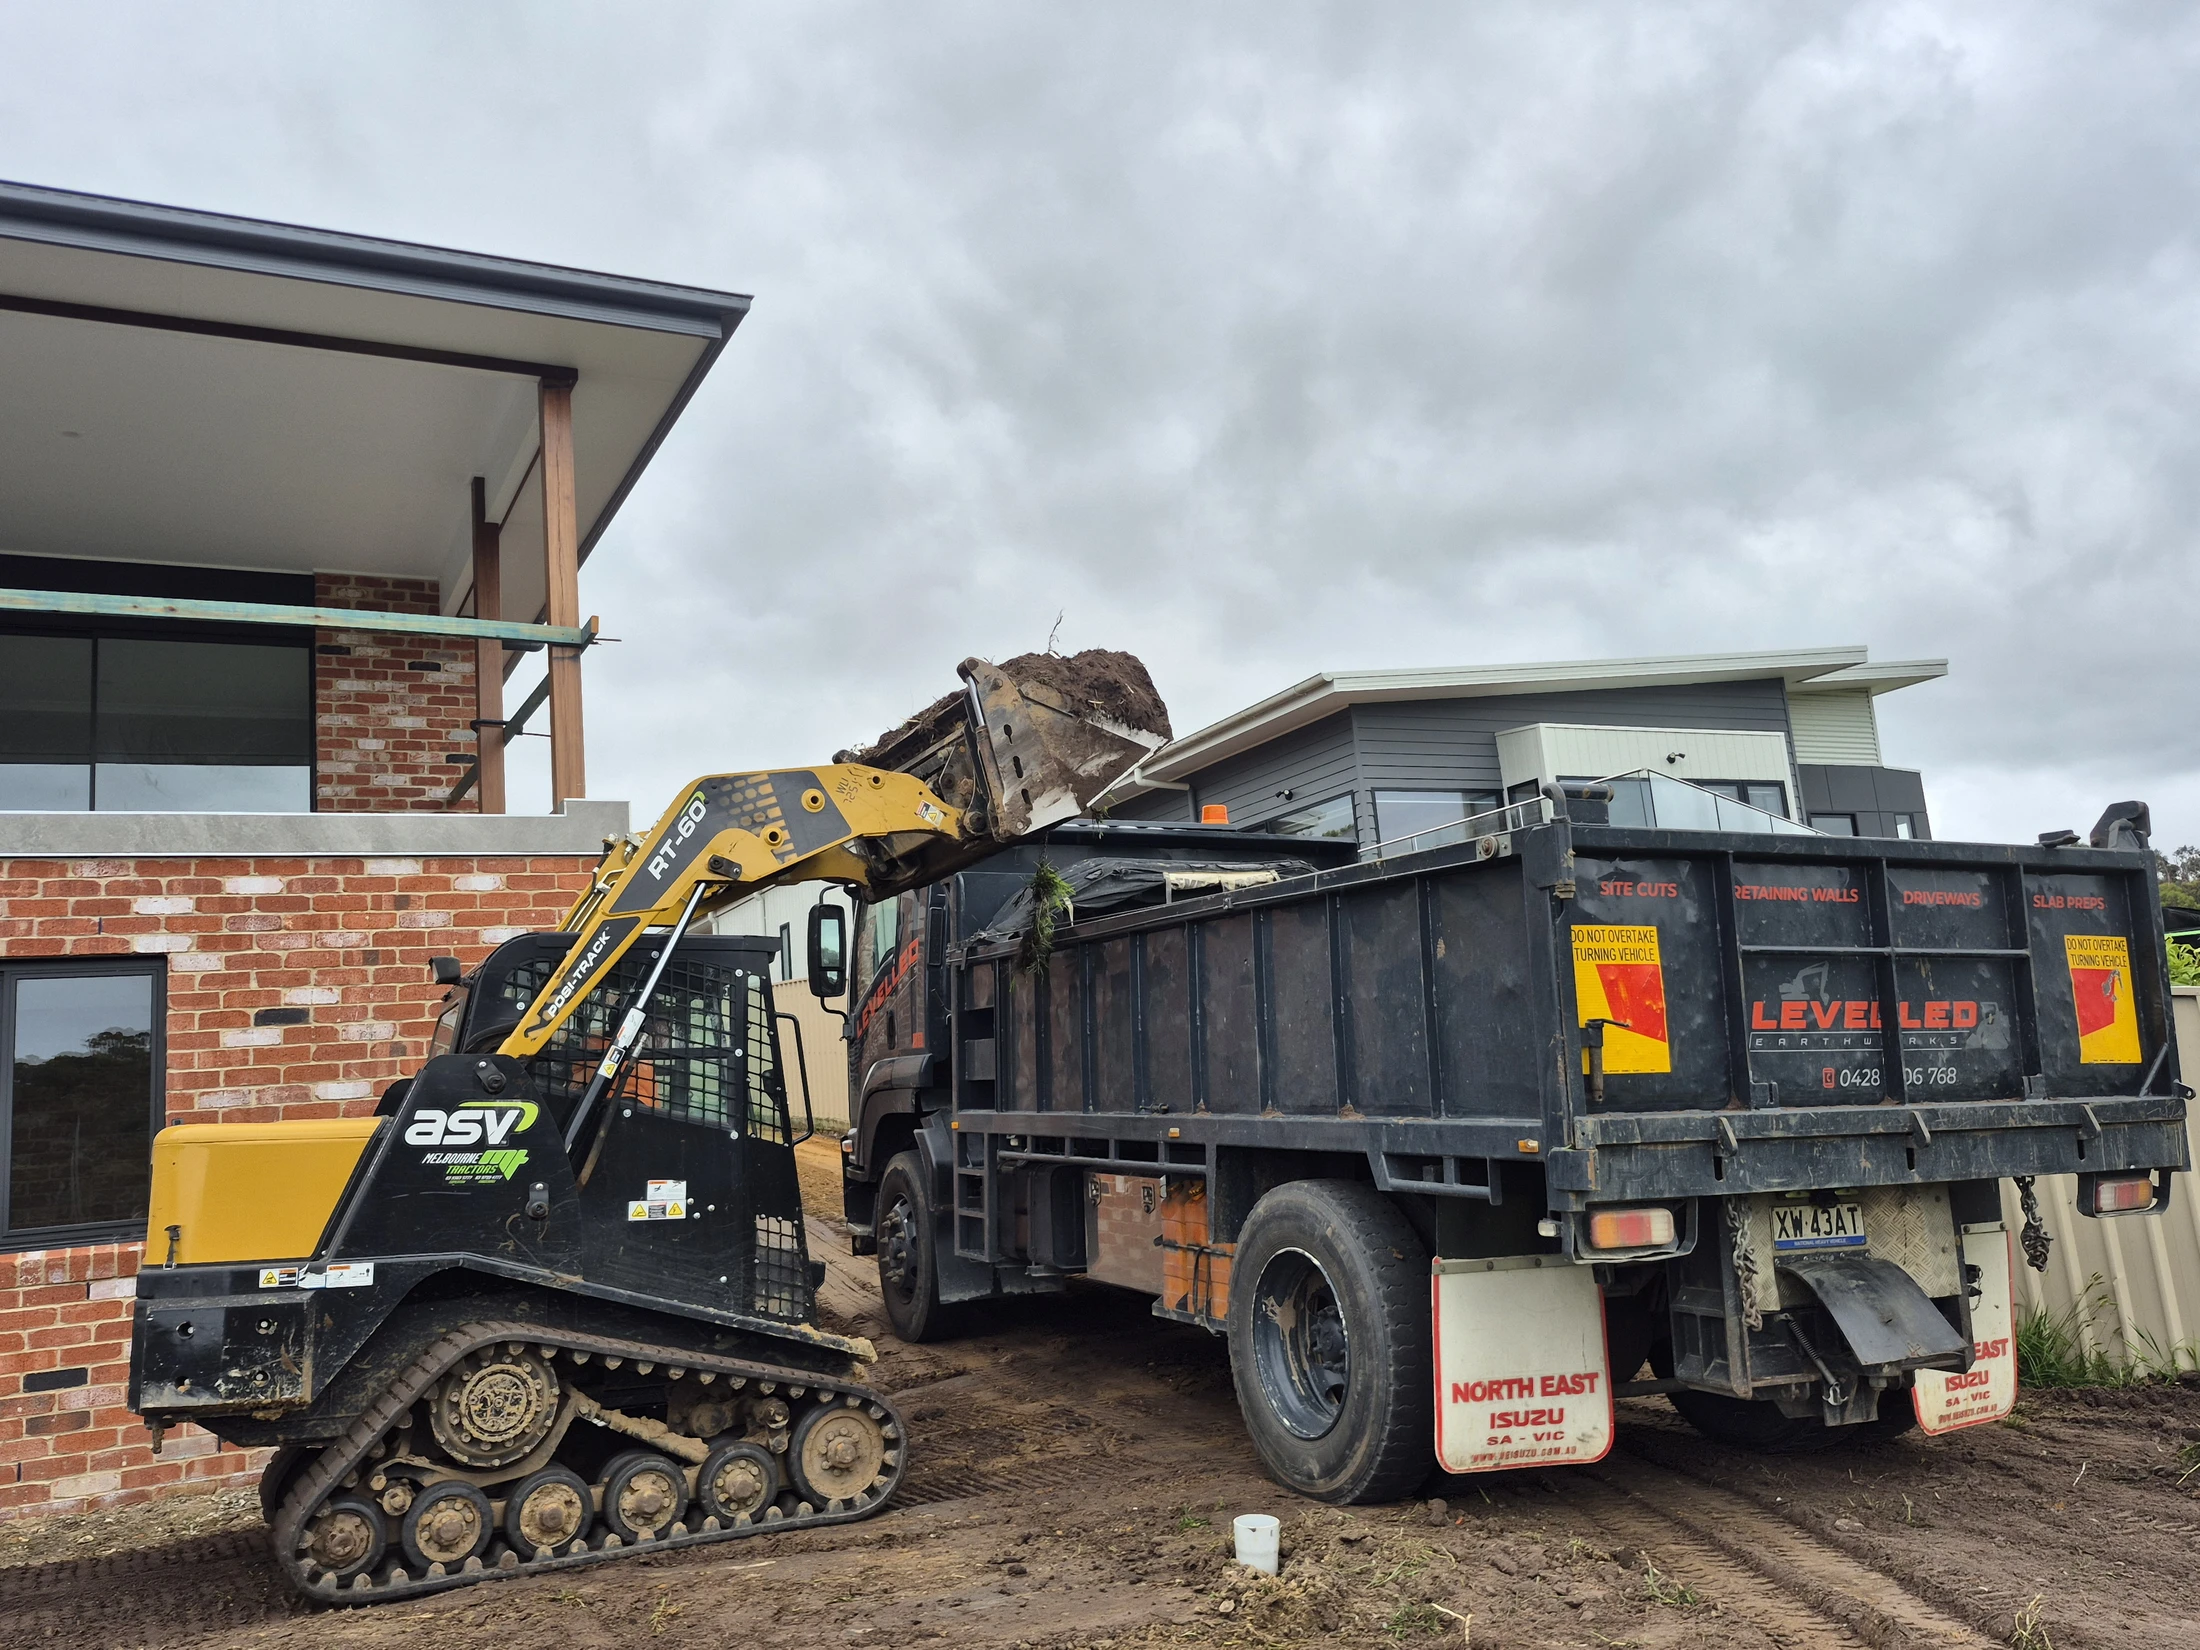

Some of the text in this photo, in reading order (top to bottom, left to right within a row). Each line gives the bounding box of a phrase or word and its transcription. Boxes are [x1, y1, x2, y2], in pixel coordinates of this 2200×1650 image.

[647, 800, 707, 881] RT-60
[1600, 881, 1677, 897] SITE CUTS
[1734, 885, 1859, 902] RETAINING WALLS
[1903, 891, 1980, 906] DRIVEWAYS
[2033, 894, 2105, 910] SLAB PREPS
[1571, 929, 1655, 944] DO NOT OVERTAKE
[2066, 937, 2127, 952] DO NOT OVERTAKE
[1574, 947, 1655, 962] TURNING VEHICLE
[2070, 954, 2128, 968] TURNING VEHICLE
[547, 930, 611, 1018] POSI-TRACK
[856, 937, 919, 1039] LEVELLED
[1755, 1036, 1957, 1047] EARTHWRKS
[1839, 1068, 1881, 1087] 0428
[1928, 1067, 1957, 1085] 768
[421, 1152, 483, 1164] MELBOURNE
[445, 1165, 498, 1175] TRACTORS
[1451, 1372, 1599, 1404] NORTH EAST
[1945, 1370, 1990, 1392] ISUZU
[1945, 1397, 1961, 1407] SA
[1970, 1391, 1991, 1402] VIC
[1490, 1408, 1564, 1429] ISUZU
[1487, 1435, 1512, 1446] SA
[1533, 1431, 1565, 1442] VIC
